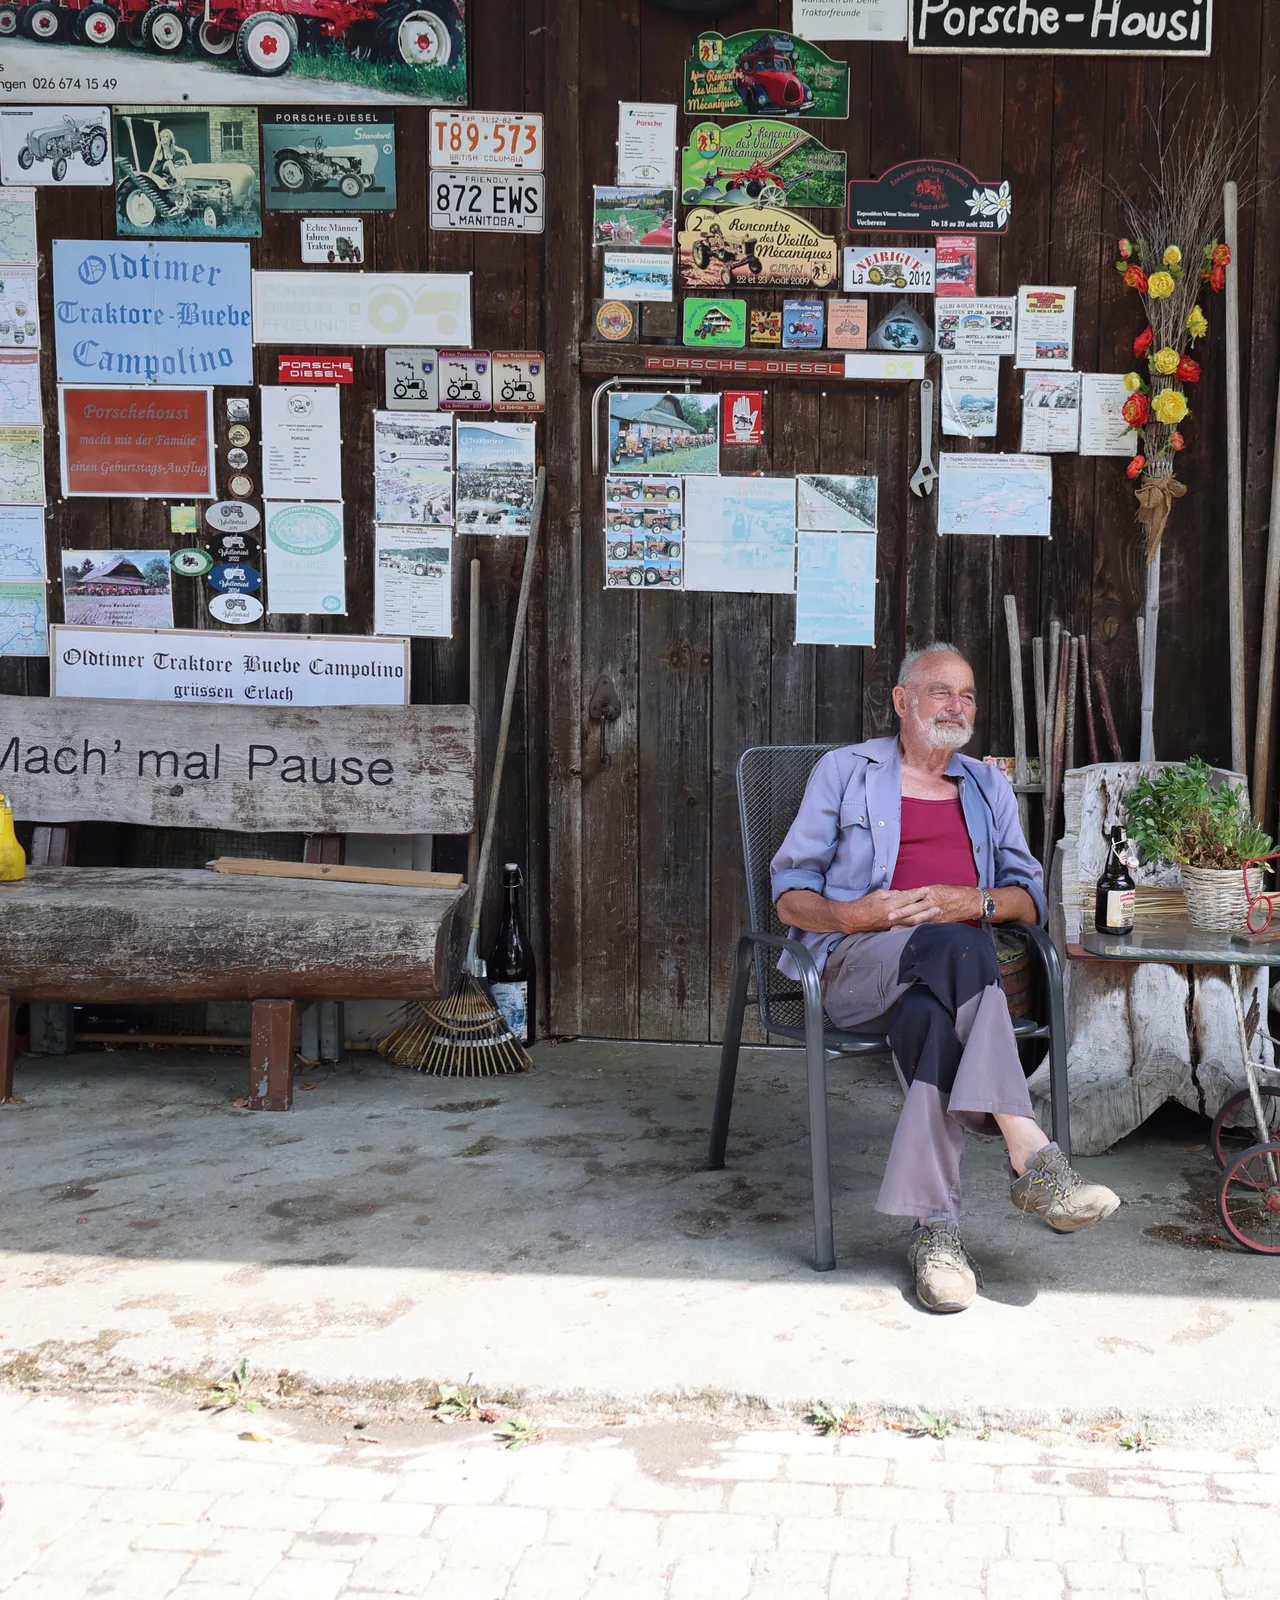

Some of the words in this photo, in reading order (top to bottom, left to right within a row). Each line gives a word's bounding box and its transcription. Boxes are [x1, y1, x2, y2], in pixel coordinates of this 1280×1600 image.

[801, 8, 861, 18] Traktorfreunde
[918, 0, 1201, 40] Porsche-Housi
[707, 68, 744, 83] Rencontre
[33, 78, 55, 89] 026
[59, 78, 81, 90] 674
[86, 78, 99, 90] 15
[102, 78, 117, 90] 49
[693, 84, 706, 96] des
[706, 83, 732, 94] Vieilles
[687, 99, 740, 113] Mécaniques
[276, 114, 378, 122] PORSCHE-DIESEL
[353, 128, 392, 140] Standard
[757, 127, 800, 139] Rencontre
[736, 138, 749, 148] des
[753, 137, 784, 149] Vieilles
[720, 146, 773, 158] Mécaniques
[945, 169, 968, 188] Tracteurs
[437, 184, 482, 212] 872
[493, 186, 538, 214] EWS
[306, 224, 328, 232] Echte
[329, 223, 358, 232] Männer
[459, 216, 514, 226] MANITOBA
[729, 219, 790, 232] Rencontre
[306, 233, 330, 241] fahren
[760, 234, 774, 243] des
[776, 234, 819, 247] Vieilles
[306, 242, 334, 250] Traktor
[756, 245, 832, 262] Mécaniques
[856, 252, 922, 272] NEIRIGUE
[78, 253, 222, 287] Oldtimer
[769, 276, 788, 284] Août
[852, 270, 863, 285] La
[909, 271, 930, 286] 2012
[262, 318, 362, 333] FREUNDE
[73, 340, 233, 380] Campolino
[647, 358, 747, 371] PORSCHE
[767, 362, 841, 374] DIESEL
[83, 402, 189, 420] Porschehousi
[80, 433, 111, 445] macht
[114, 434, 132, 445] mit
[135, 434, 152, 446] der
[155, 434, 196, 446] Familie
[70, 461, 97, 472] einen
[100, 461, 207, 476] Geburtstags-Ausflug
[63, 648, 145, 667] Oldtimer
[152, 652, 232, 673] Traktore
[243, 655, 300, 674] Buebe
[309, 658, 403, 679] Campolino
[174, 683, 233, 698] grüssen
[245, 685, 293, 702] Erlach
[138, 744, 220, 780] mal
[249, 744, 395, 785] Pause
